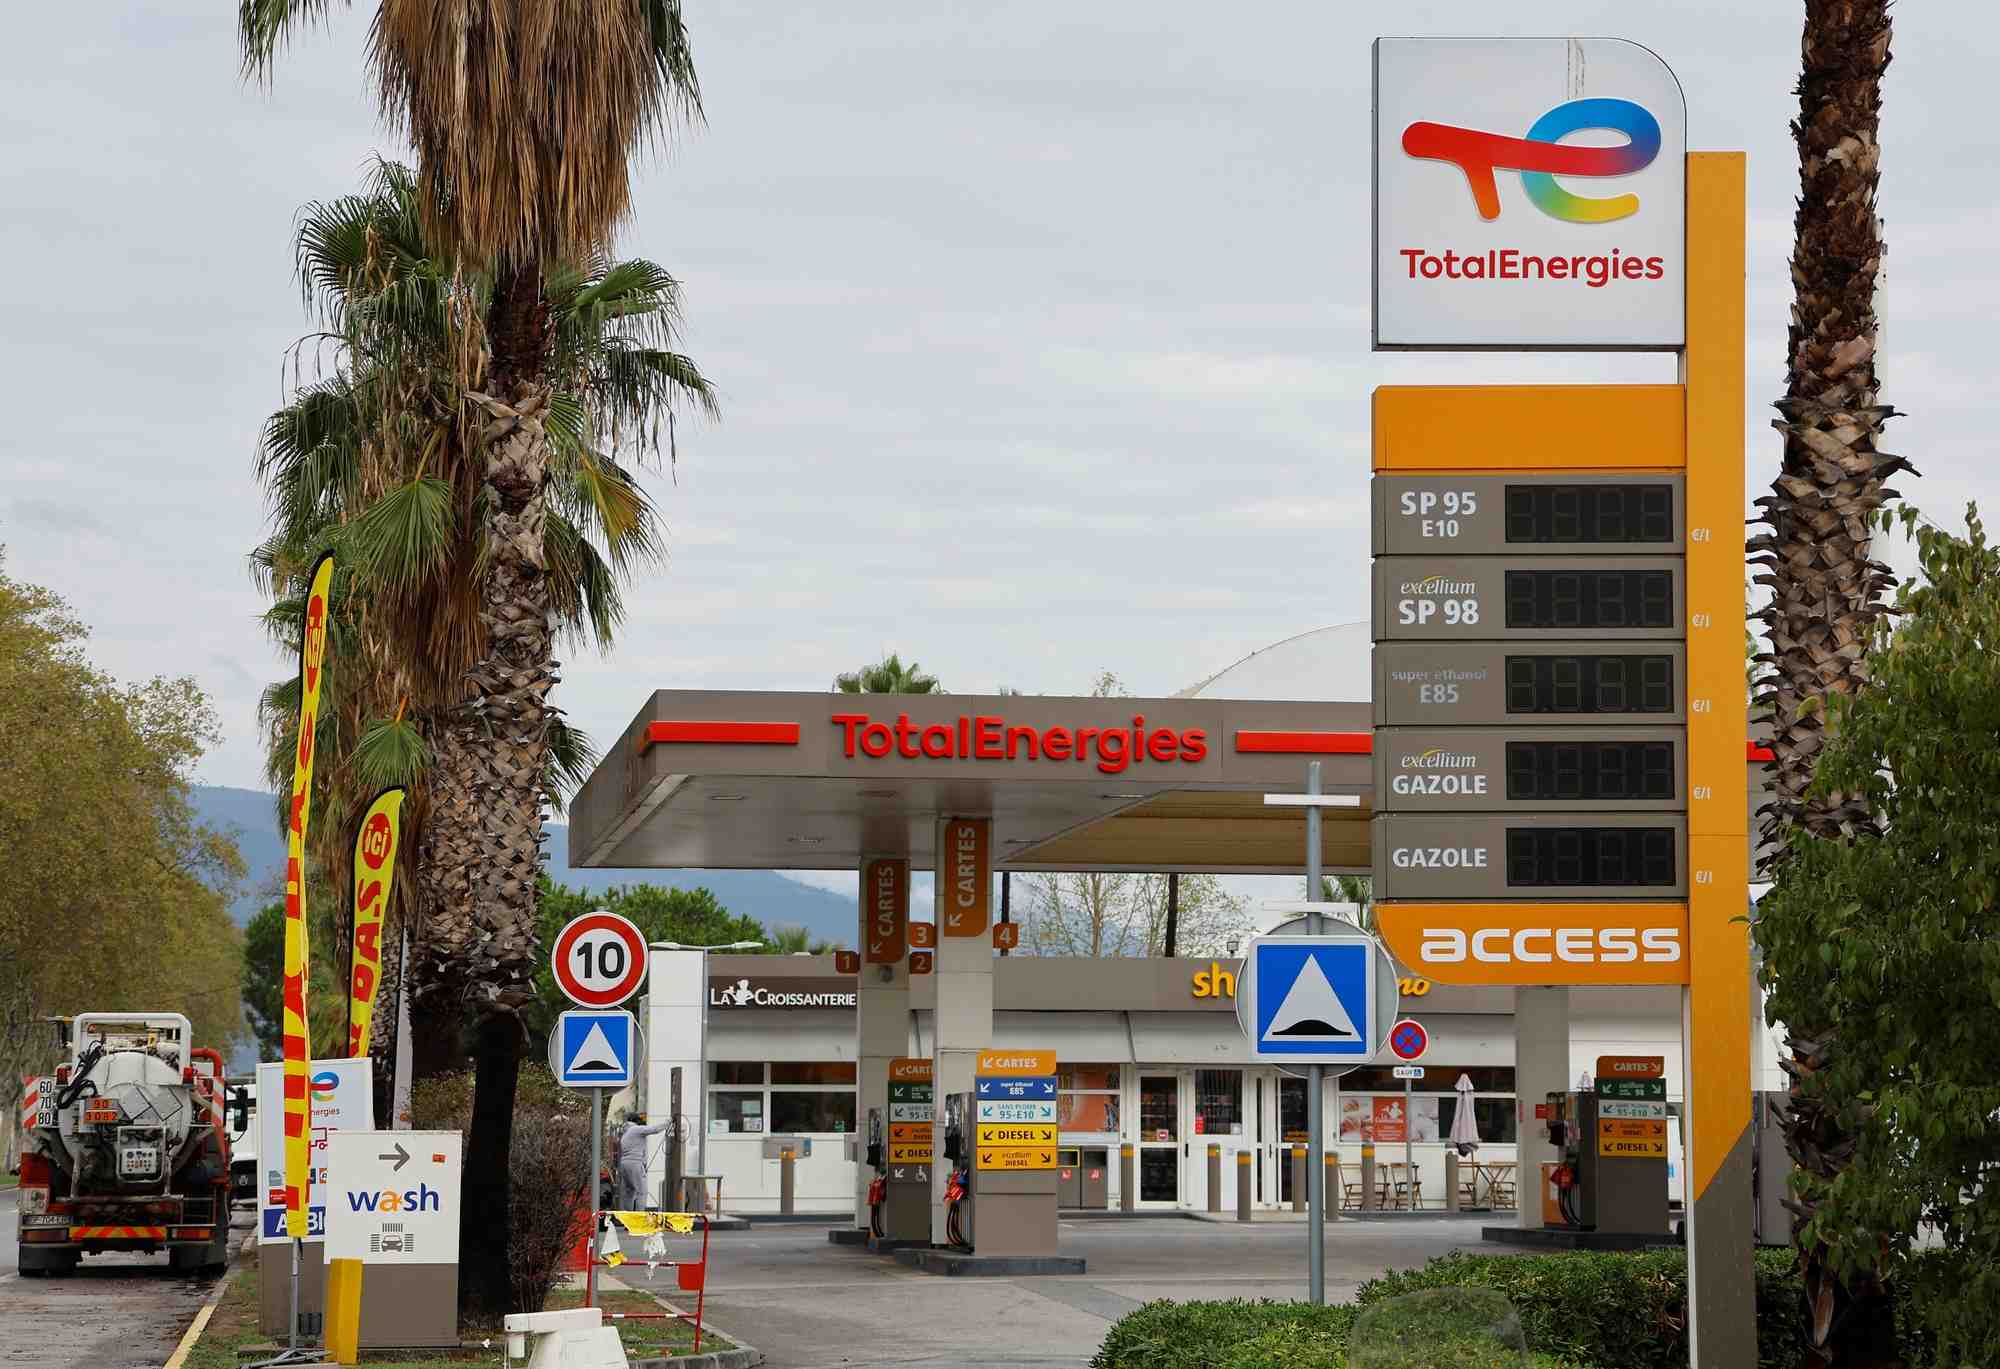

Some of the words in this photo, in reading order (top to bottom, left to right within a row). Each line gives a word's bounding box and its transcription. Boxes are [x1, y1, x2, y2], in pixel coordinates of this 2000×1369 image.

[1399, 248, 1664, 287] TotalEnergies
[1400, 491, 1437, 515] SP
[1443, 491, 1477, 515] 95
[1421, 519, 1459, 537] E10
[1400, 578, 1476, 595] excellium
[1398, 599, 1436, 625] SP
[1443, 599, 1480, 625] 98
[1419, 683, 1460, 704] E85
[831, 713, 1208, 774] TotalEnergies
[1400, 752, 1477, 768] excellium
[1392, 774, 1488, 795] GAZOLE
[363, 822, 390, 858] ici
[1392, 847, 1488, 868] GAZOLE
[957, 826, 977, 907] CARTES
[878, 866, 895, 937] CARTES
[915, 927, 928, 944] 3
[999, 928, 1012, 944] 4
[577, 941, 625, 979] 10
[842, 954, 851, 969] 1
[915, 955, 927, 970] 2
[906, 1064, 932, 1074] CART
[996, 1058, 1037, 1069] CARTES
[39, 1080, 52, 1094] 60
[39, 1096, 52, 1109] 70
[38, 1112, 51, 1125] 80
[999, 1110, 1035, 1120] 95-E10
[998, 1130, 1036, 1140] DIESEL
[1616, 1143, 1649, 1152] DIESEL
[347, 1182, 440, 1212] wash
